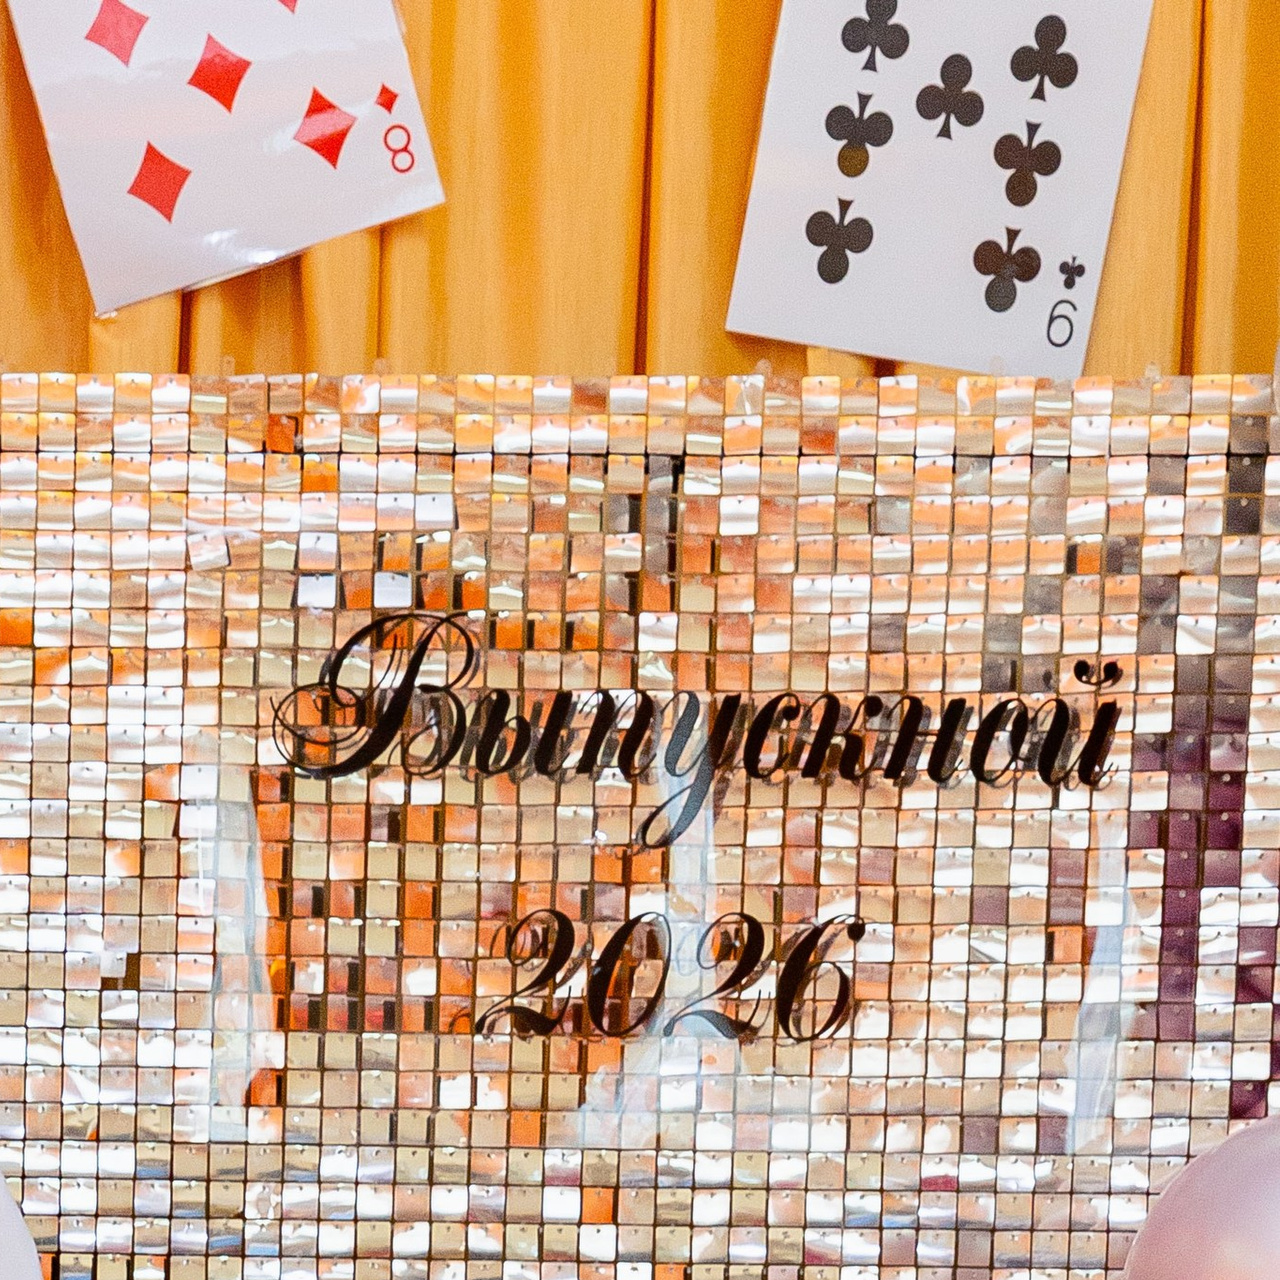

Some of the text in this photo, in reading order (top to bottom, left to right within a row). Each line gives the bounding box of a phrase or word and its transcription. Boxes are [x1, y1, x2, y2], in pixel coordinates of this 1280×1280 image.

[383, 124, 415, 174] 8
[273, 610, 1122, 850] Выпускной
[474, 908, 867, 1043] 2026
